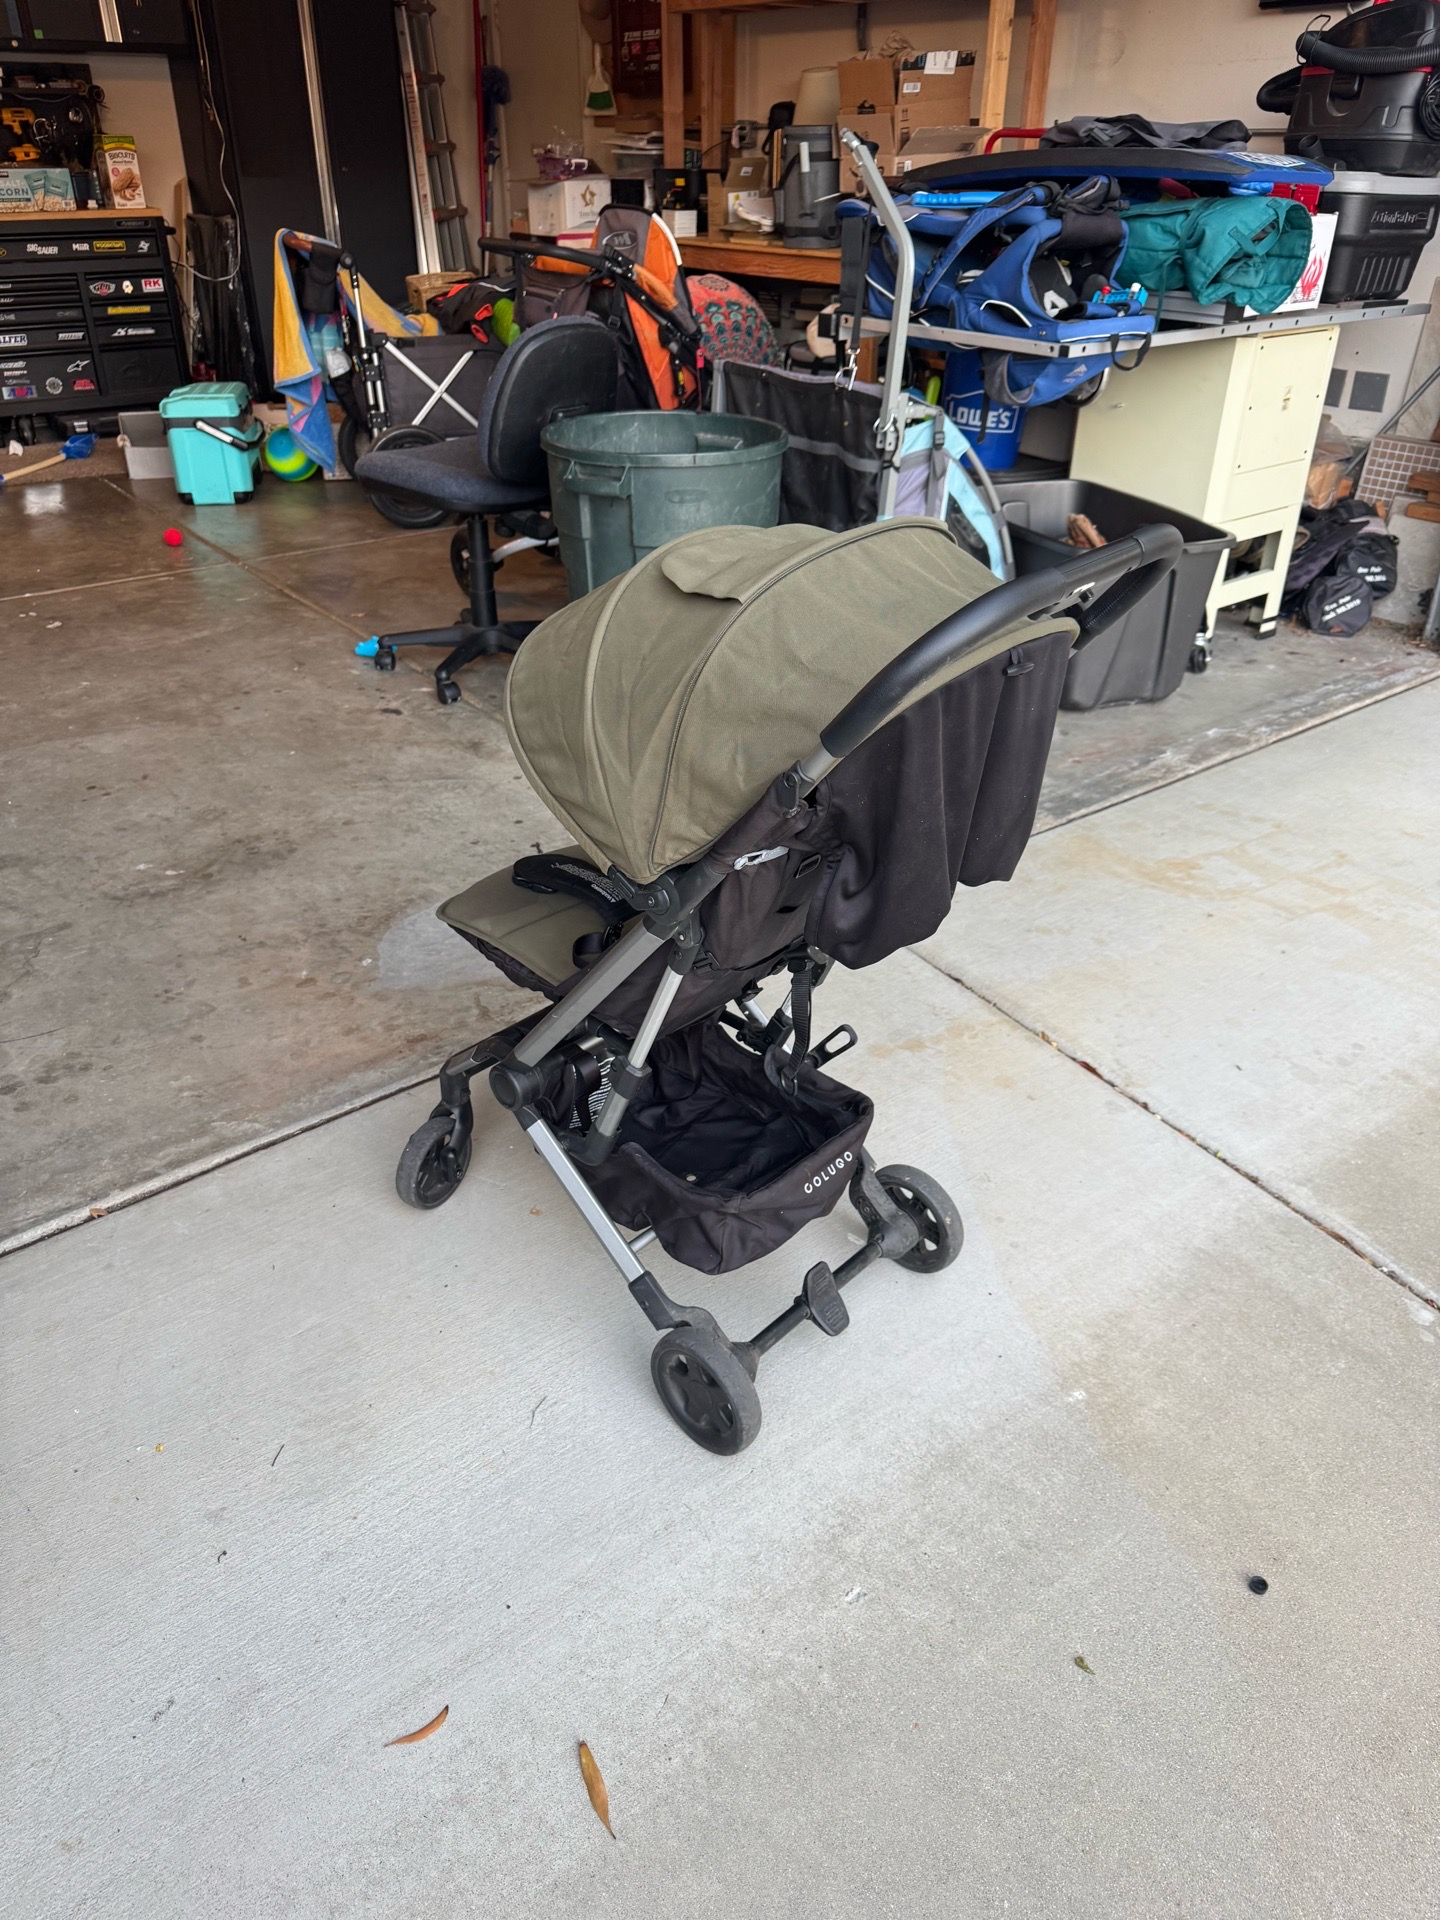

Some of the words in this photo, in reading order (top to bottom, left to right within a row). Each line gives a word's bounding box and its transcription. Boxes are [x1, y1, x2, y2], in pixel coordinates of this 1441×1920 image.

[27, 243, 38, 252] SIG
[37, 246, 58, 255] SAUER
[143, 279, 162, 288] RK
[804, 1151, 853, 1194] COLUGO
